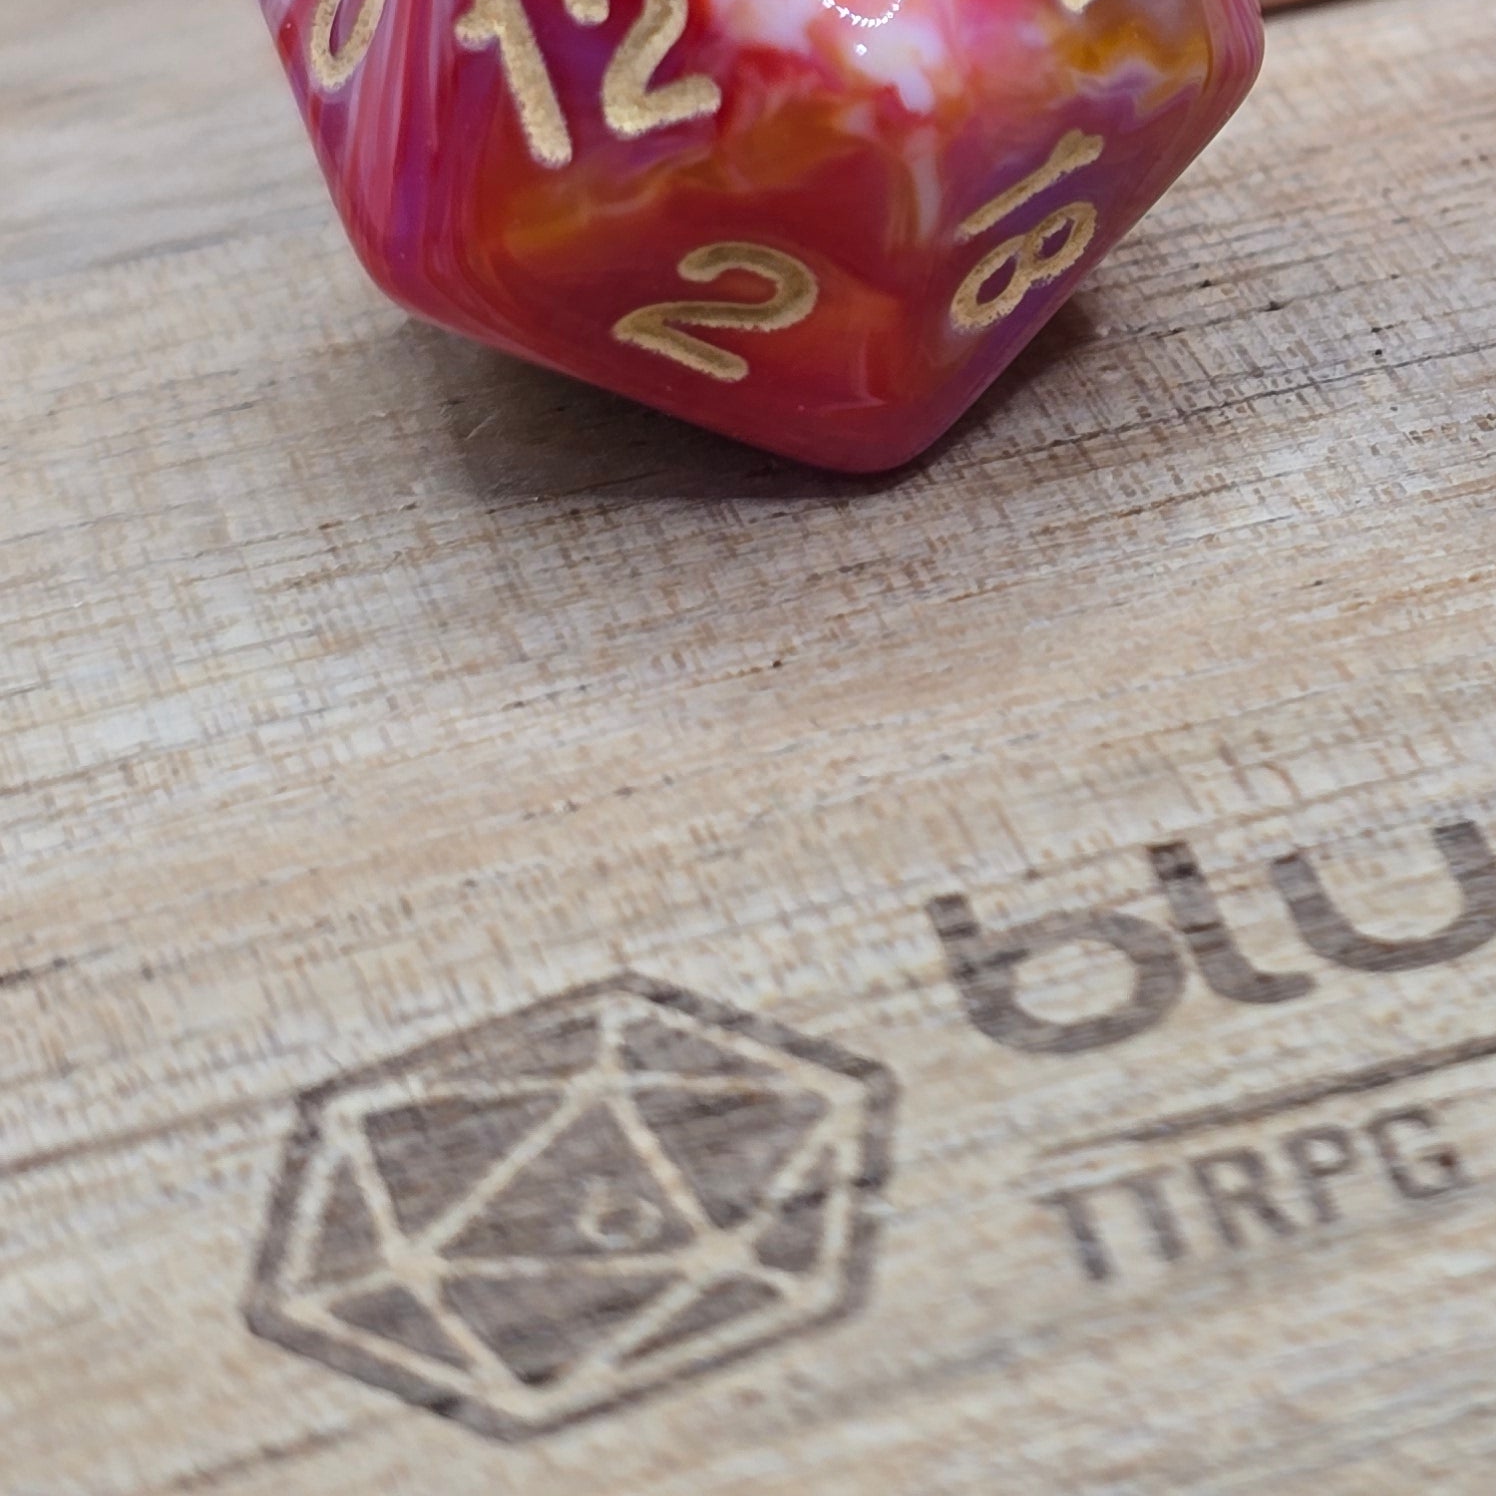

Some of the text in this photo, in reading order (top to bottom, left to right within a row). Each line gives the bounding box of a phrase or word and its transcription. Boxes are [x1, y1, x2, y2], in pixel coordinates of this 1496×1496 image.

[611, 241, 820, 384] 2
[951, 128, 1103, 333] 18
[1037, 1102, 1473, 1284] TTRPG
